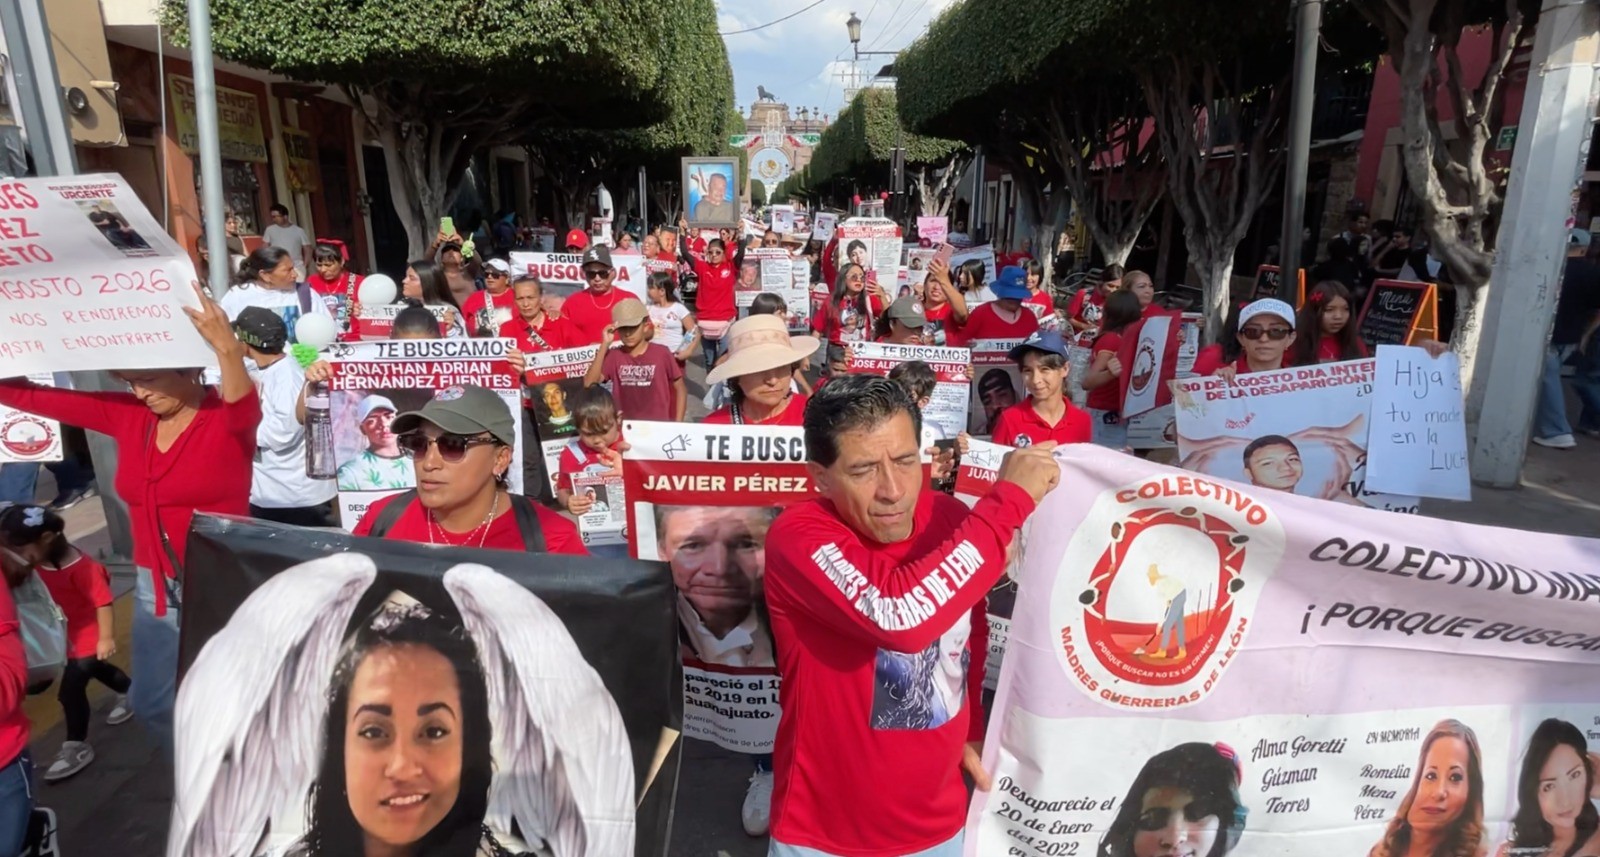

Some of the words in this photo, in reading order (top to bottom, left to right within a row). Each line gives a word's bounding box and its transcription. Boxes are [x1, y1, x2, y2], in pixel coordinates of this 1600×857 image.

[60, 189, 115, 199] URGENTE
[0, 217, 40, 240] EZ
[0, 243, 54, 267] ETO
[91, 269, 171, 293] 2026
[527, 263, 630, 282] BUSQA
[9, 312, 47, 327] NOS
[62, 304, 171, 324] RENDIREMOS
[0, 339, 46, 360] ASTA
[62, 331, 174, 350] ENCONTRARTE
[375, 343, 399, 357] TE
[900, 347, 968, 360] BUSCAMOS
[551, 354, 565, 364] TE
[566, 349, 599, 362] BUSC
[851, 359, 875, 369] JOSE
[337, 363, 428, 376] JONATHAN
[432, 361, 492, 375] ADRIAN
[534, 367, 562, 377] VICTOR
[333, 373, 436, 390] HERNÁNDEZ
[1204, 380, 1227, 390] DE
[1228, 373, 1293, 388] AGOSTO
[1297, 368, 1327, 380] DIA
[1395, 360, 1443, 399] Hija
[1206, 391, 1227, 401] DE
[1230, 388, 1249, 398] LA
[1386, 402, 1411, 422] tu
[1391, 431, 1416, 444] en
[1427, 427, 1438, 445] la
[705, 435, 730, 460] TE
[742, 436, 802, 462] BUSC
[643, 474, 726, 491] JAVIER
[734, 472, 808, 492] PÉREZ
[1115, 476, 1267, 525] COLECTIVO
[922, 568, 956, 607] DE
[939, 539, 986, 589] LEON
[1309, 537, 1538, 595] COLECTIVO
[1321, 602, 1483, 636] PORQUE
[1061, 626, 1099, 692] MADRES
[1100, 688, 1201, 708] GUERRERAS
[1203, 670, 1219, 692] DE
[1219, 617, 1248, 666] LEÓN
[1122, 663, 1153, 678] BUSCAR
[1181, 665, 1192, 675] UN
[748, 680, 763, 690] el
[705, 687, 742, 703] 2019
[747, 696, 767, 704] en
[1366, 730, 1378, 744] EN
[1379, 727, 1420, 744] MEMORIA
[1252, 738, 1287, 762] Alma
[1290, 735, 1347, 755] Goretti
[1261, 765, 1318, 793] Gúzman
[1360, 764, 1411, 780] Romelia
[999, 776, 1097, 814] Desaparecio
[1100, 796, 1116, 811] el
[1358, 784, 1398, 800] Mena
[1266, 797, 1310, 815] Torres
[1353, 804, 1386, 821] Pérez
[996, 801, 1022, 822] 20
[1023, 818, 1046, 832] de
[1048, 820, 1093, 835] Enero
[1007, 829, 1035, 846] del
[1034, 840, 1080, 857] 2022
